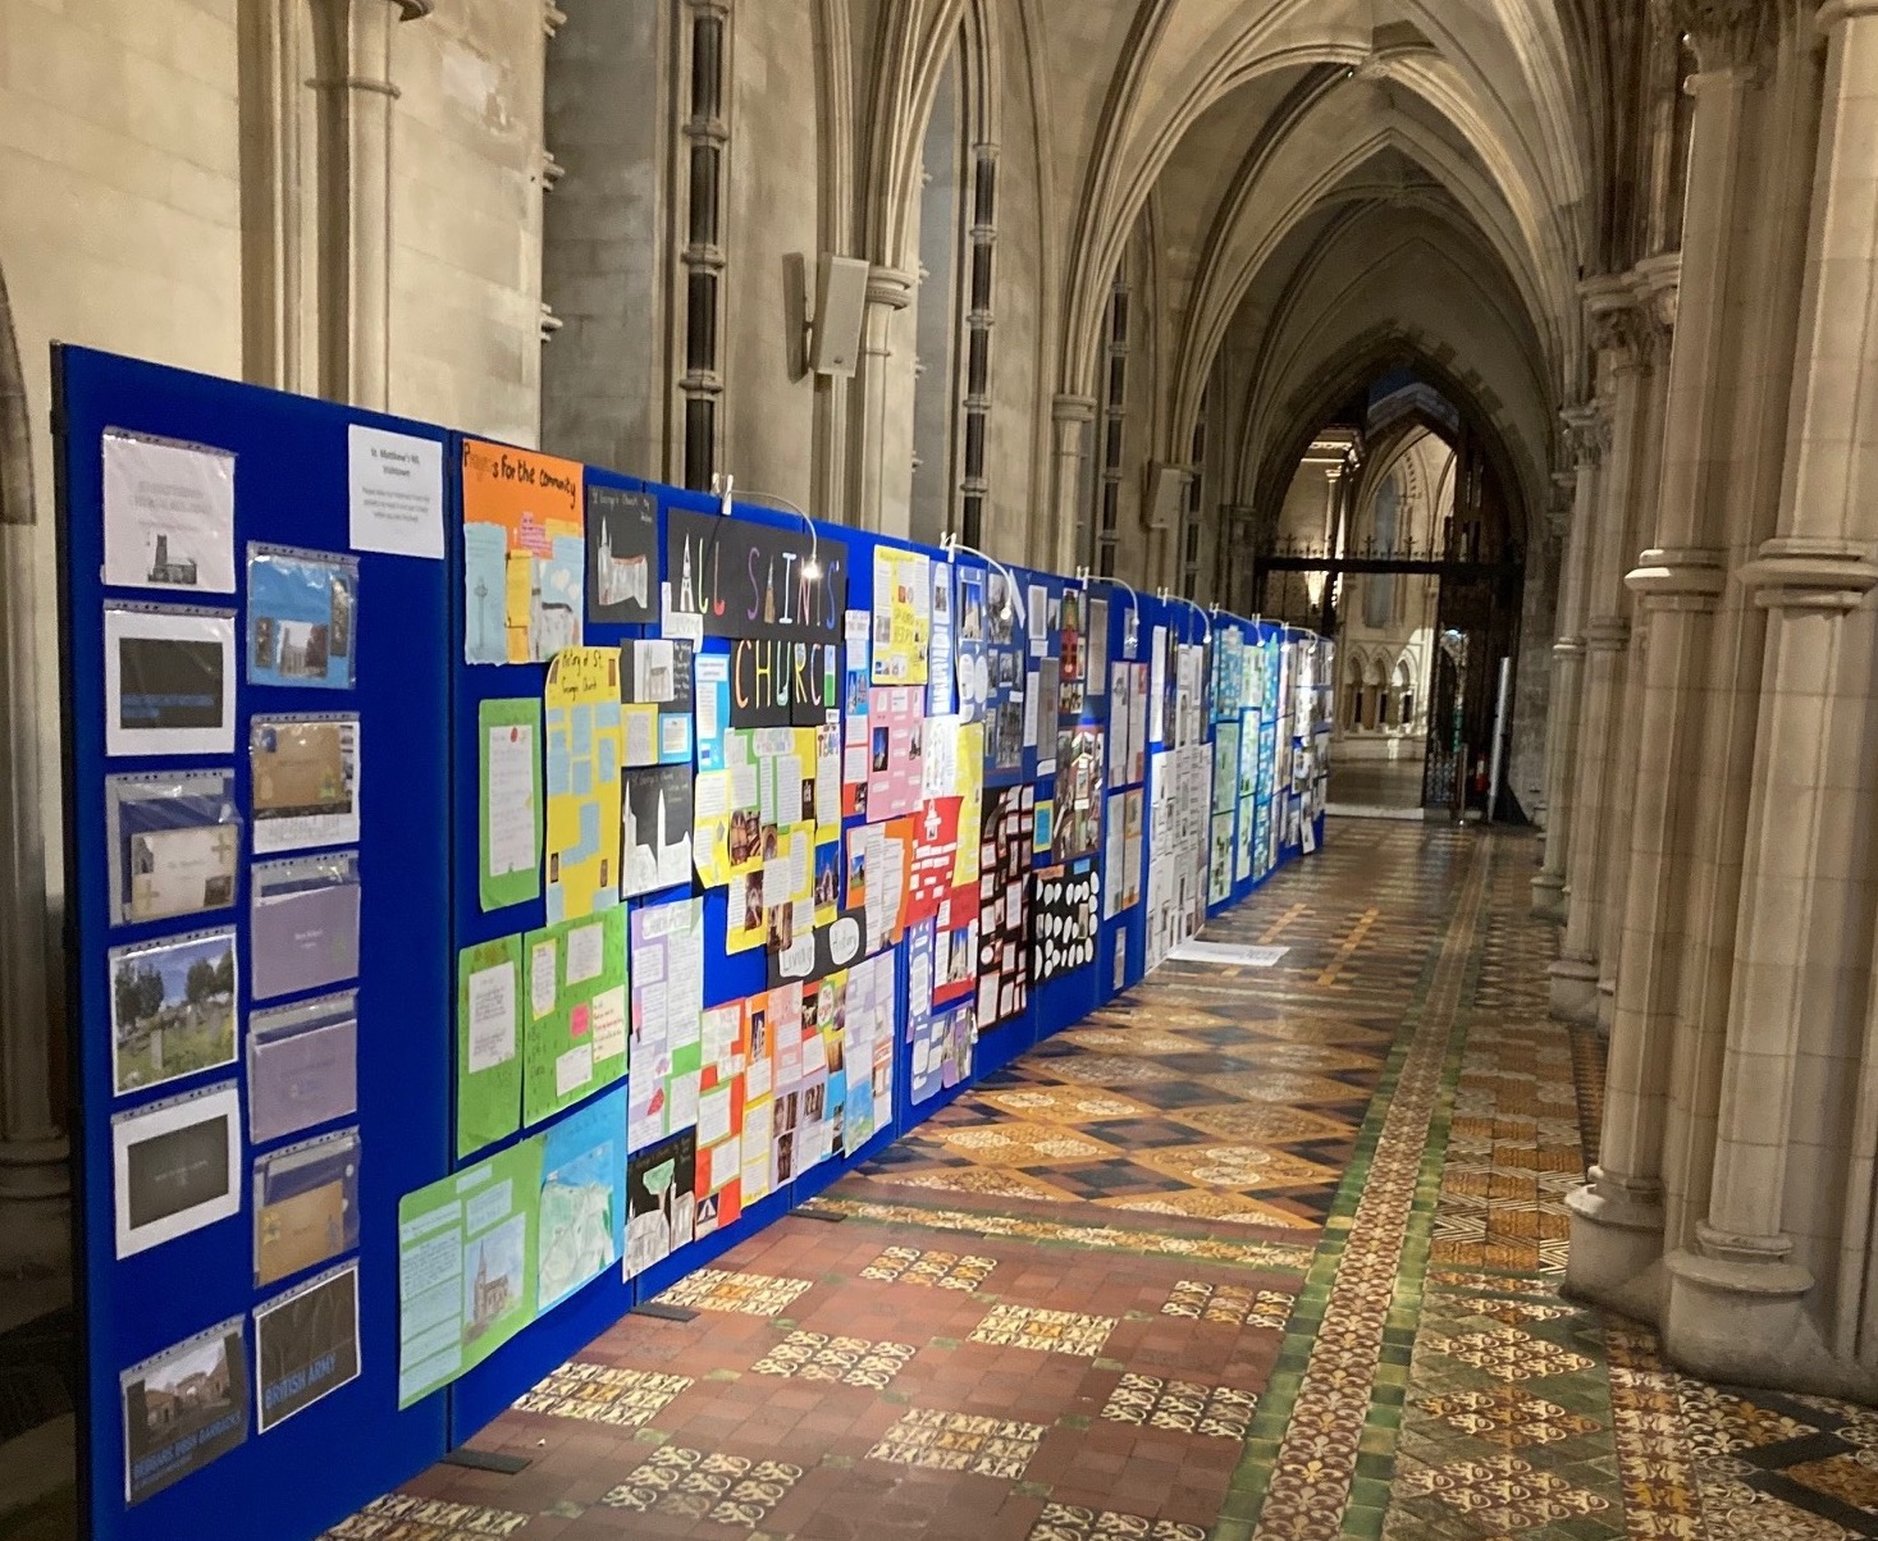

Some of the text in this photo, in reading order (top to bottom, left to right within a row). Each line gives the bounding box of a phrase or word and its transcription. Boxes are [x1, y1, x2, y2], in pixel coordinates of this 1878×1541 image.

[501, 454, 516, 479] for
[518, 460, 535, 484] the
[680, 532, 726, 616] ALL
[735, 640, 837, 709] CHURCH
